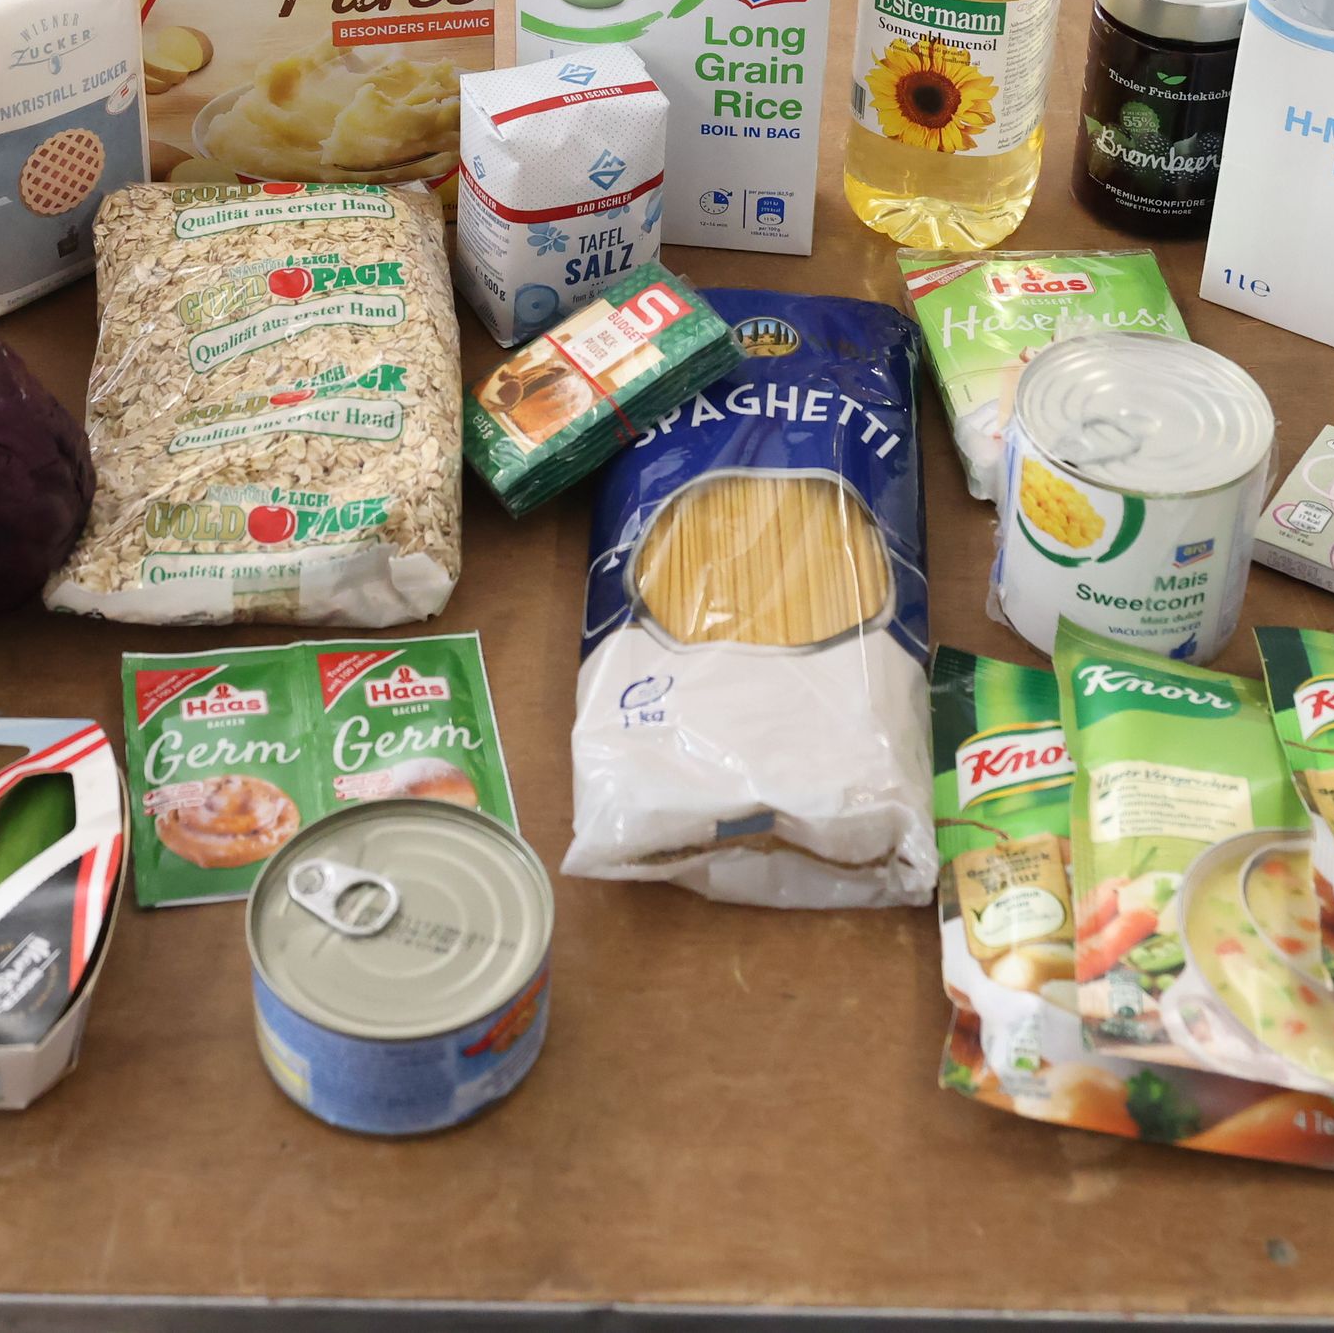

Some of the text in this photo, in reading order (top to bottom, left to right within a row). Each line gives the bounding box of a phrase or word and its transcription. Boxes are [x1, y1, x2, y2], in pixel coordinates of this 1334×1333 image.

[21, 13, 80, 42] WIENER
[340, 17, 490, 38] BESONDERS FLAUMIG
[704, 16, 807, 56] Long
[878, 16, 997, 52] Sonnenblumenöl
[10, 28, 92, 67] ZUCKER
[83, 60, 128, 93] ZUCKER
[694, 52, 804, 86] Grain
[1108, 68, 1146, 93] Tiroler
[563, 84, 623, 105] BAD ISCHLER
[713, 88, 804, 121] Rice
[700, 123, 801, 140] BOIL IN BAG
[1123, 116, 1156, 129] 55%
[171, 184, 261, 205] GOLD
[577, 192, 633, 215] BAD ISCHLER
[1105, 183, 1206, 207] PREMIUMKONFITÜRE
[1116, 197, 1192, 215] CONFETTURA MORE
[181, 199, 387, 232] Qualität aus erster Hand
[579, 226, 625, 254] TAFEL
[301, 253, 341, 265] LICH
[565, 243, 634, 286] SALZ
[178, 262, 405, 327] GOLD PACK
[483, 274, 499, 295] 500
[991, 274, 1088, 294] Haas
[1021, 297, 1074, 307] DESSERT
[195, 300, 398, 364] Qualität aus erster Hand
[607, 311, 645, 344] BUDGET
[311, 365, 347, 387] LICH
[175, 426, 247, 448] Qualität
[346, 407, 396, 429] Hand
[289, 491, 330, 507] LICH
[144, 496, 390, 542] GOLD PACK
[1183, 543, 1208, 556] aro
[1154, 572, 1209, 593] Mais
[1076, 582, 1206, 612] Sweetcorn
[1108, 621, 1202, 637] VACUUM PACKED
[326, 653, 360, 679] Tradition
[370, 682, 445, 703] Haas
[1078, 664, 1233, 710] Knorr
[186, 697, 263, 718] Haas
[392, 704, 431, 717] BACKEN
[207, 718, 246, 730] BACKEN
[333, 715, 485, 773] Germ
[143, 729, 302, 786] Germ
[1293, 1111, 1306, 1131] 4
